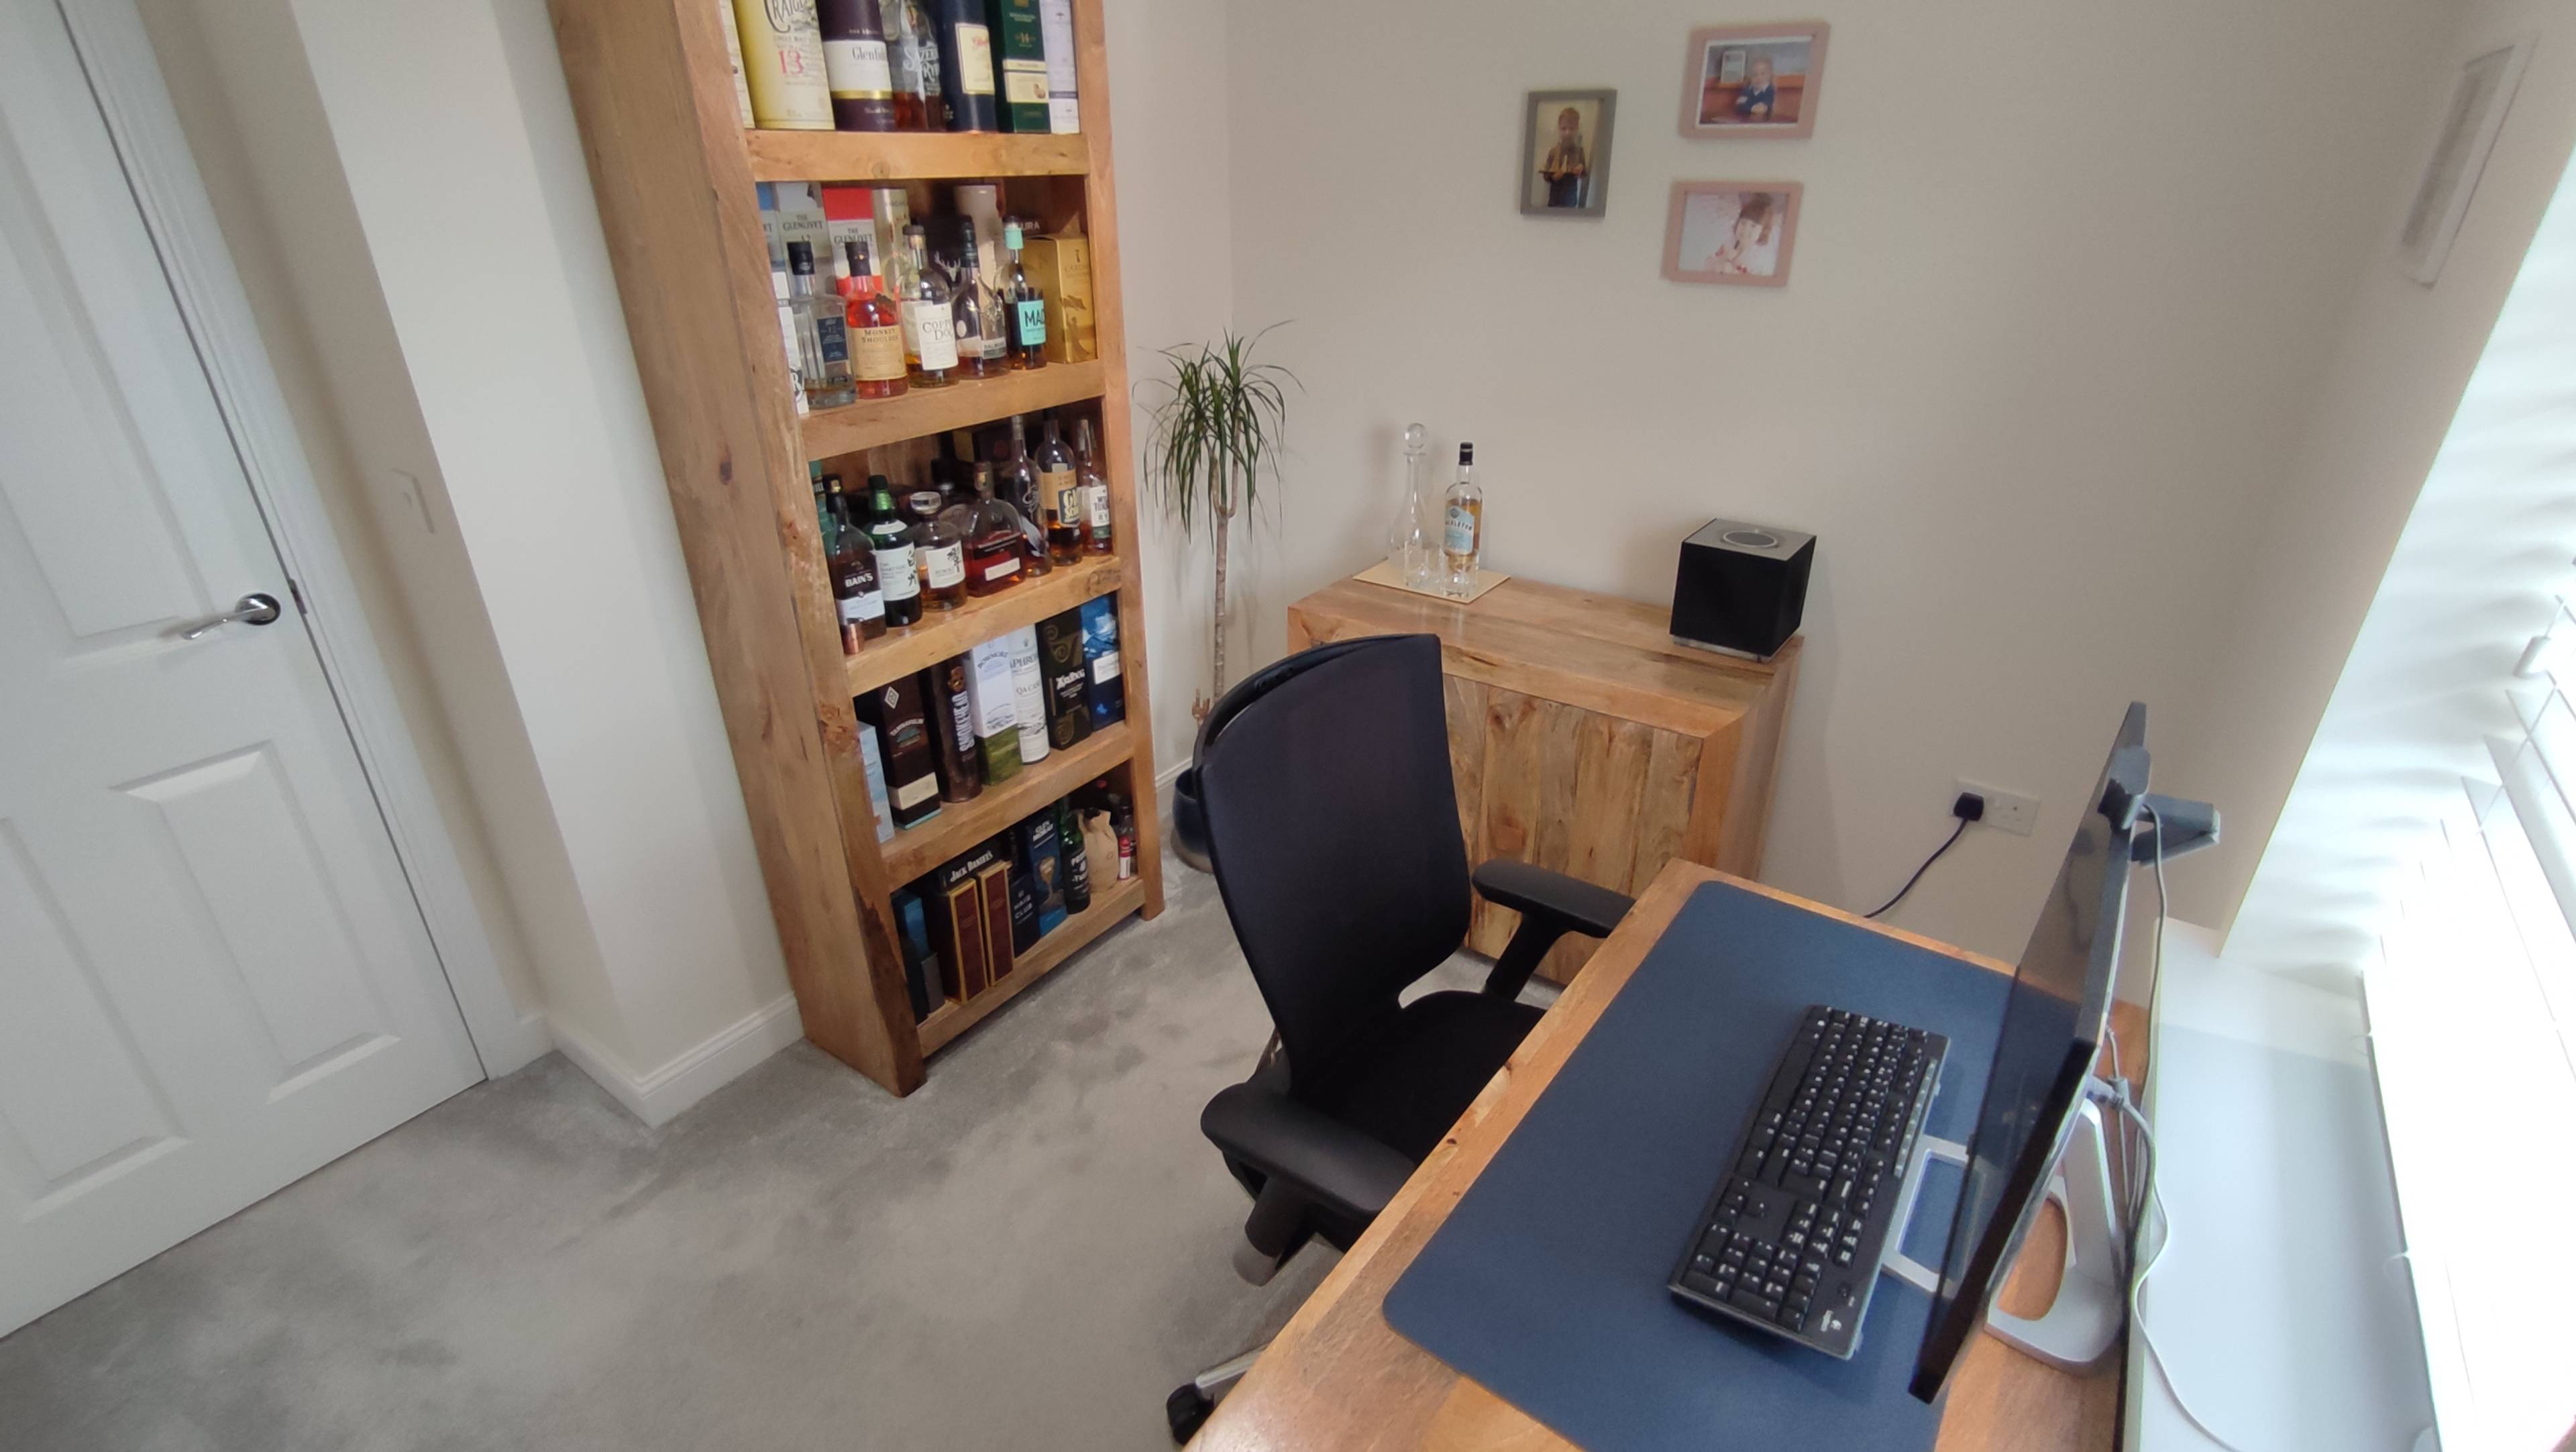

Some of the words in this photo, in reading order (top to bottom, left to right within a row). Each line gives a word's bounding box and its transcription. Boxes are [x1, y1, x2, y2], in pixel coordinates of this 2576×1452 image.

[779, 50, 804, 74] 13
[783, 221, 822, 231] GLENLIVET
[845, 573, 873, 588] BAIN'S
